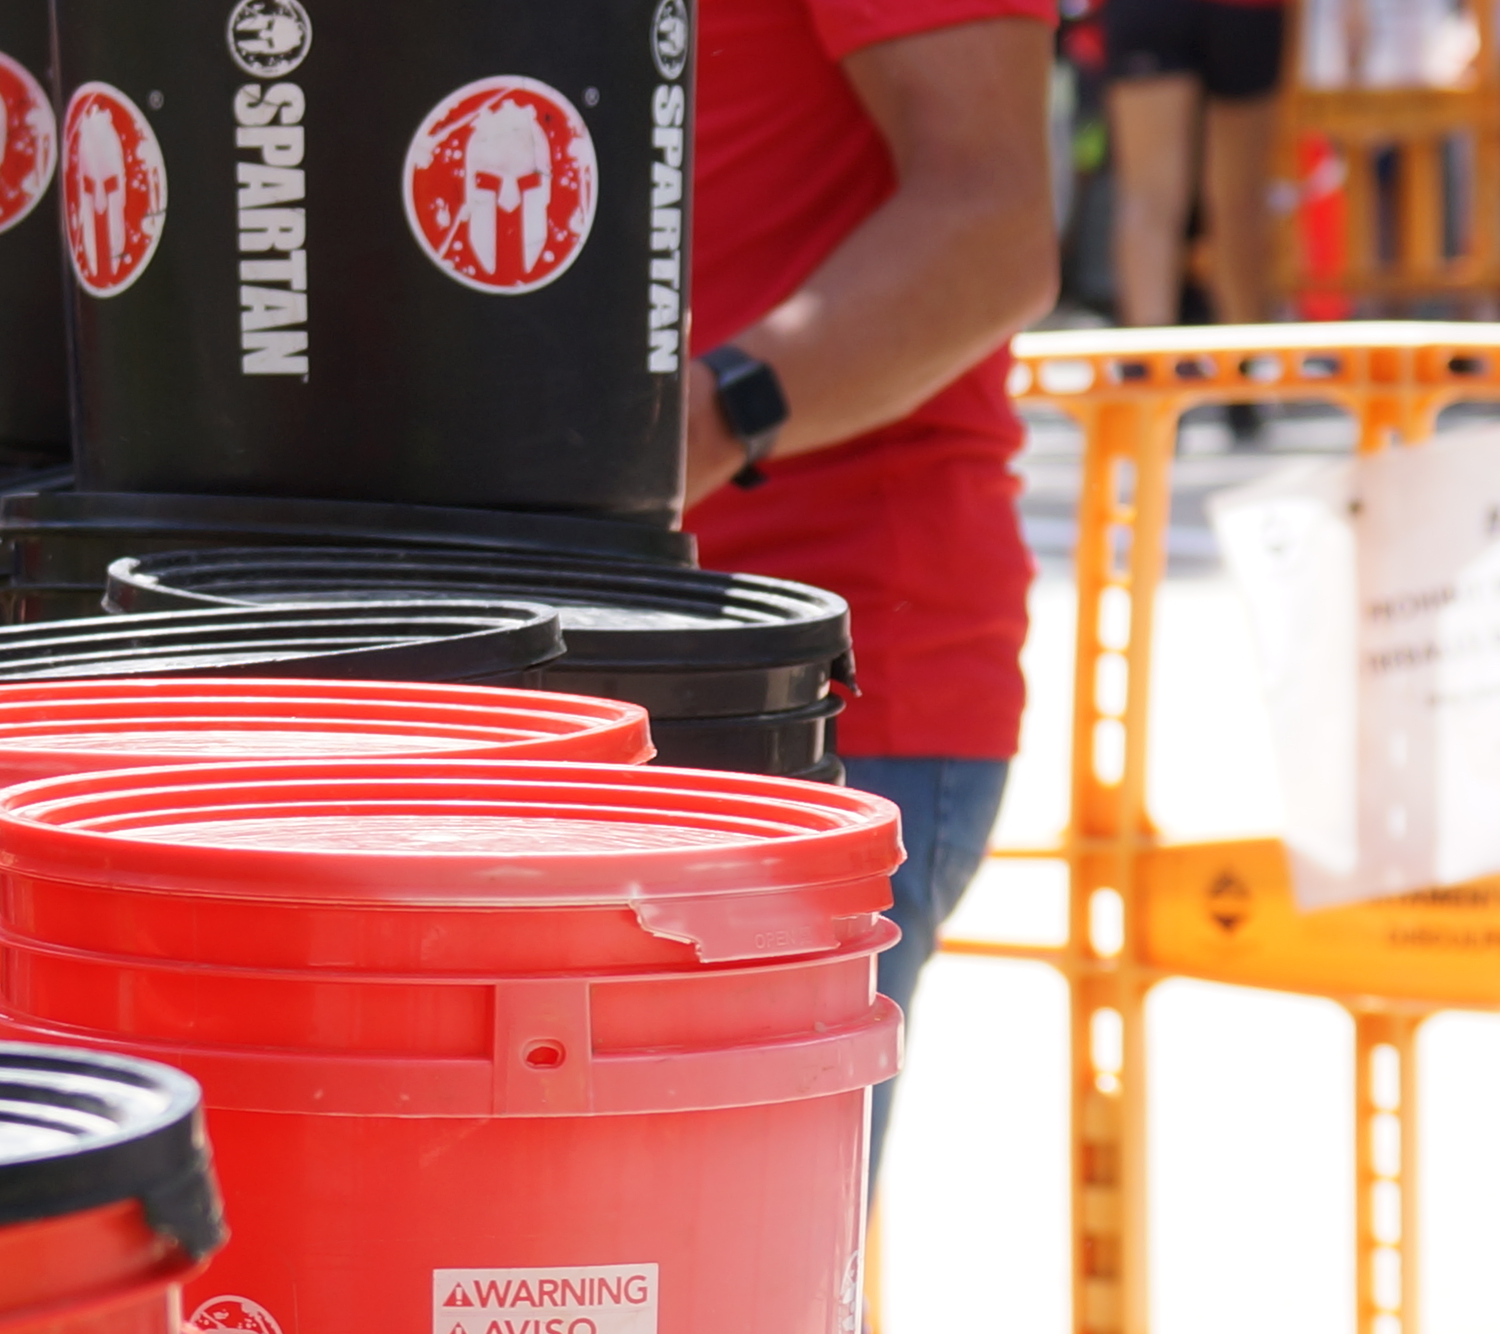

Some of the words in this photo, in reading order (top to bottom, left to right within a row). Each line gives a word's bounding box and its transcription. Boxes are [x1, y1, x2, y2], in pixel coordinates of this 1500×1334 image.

[233, 82, 309, 376] SPARTAN
[648, 83, 685, 373] SPARTAN
[474, 1273, 648, 1308] WARNING
